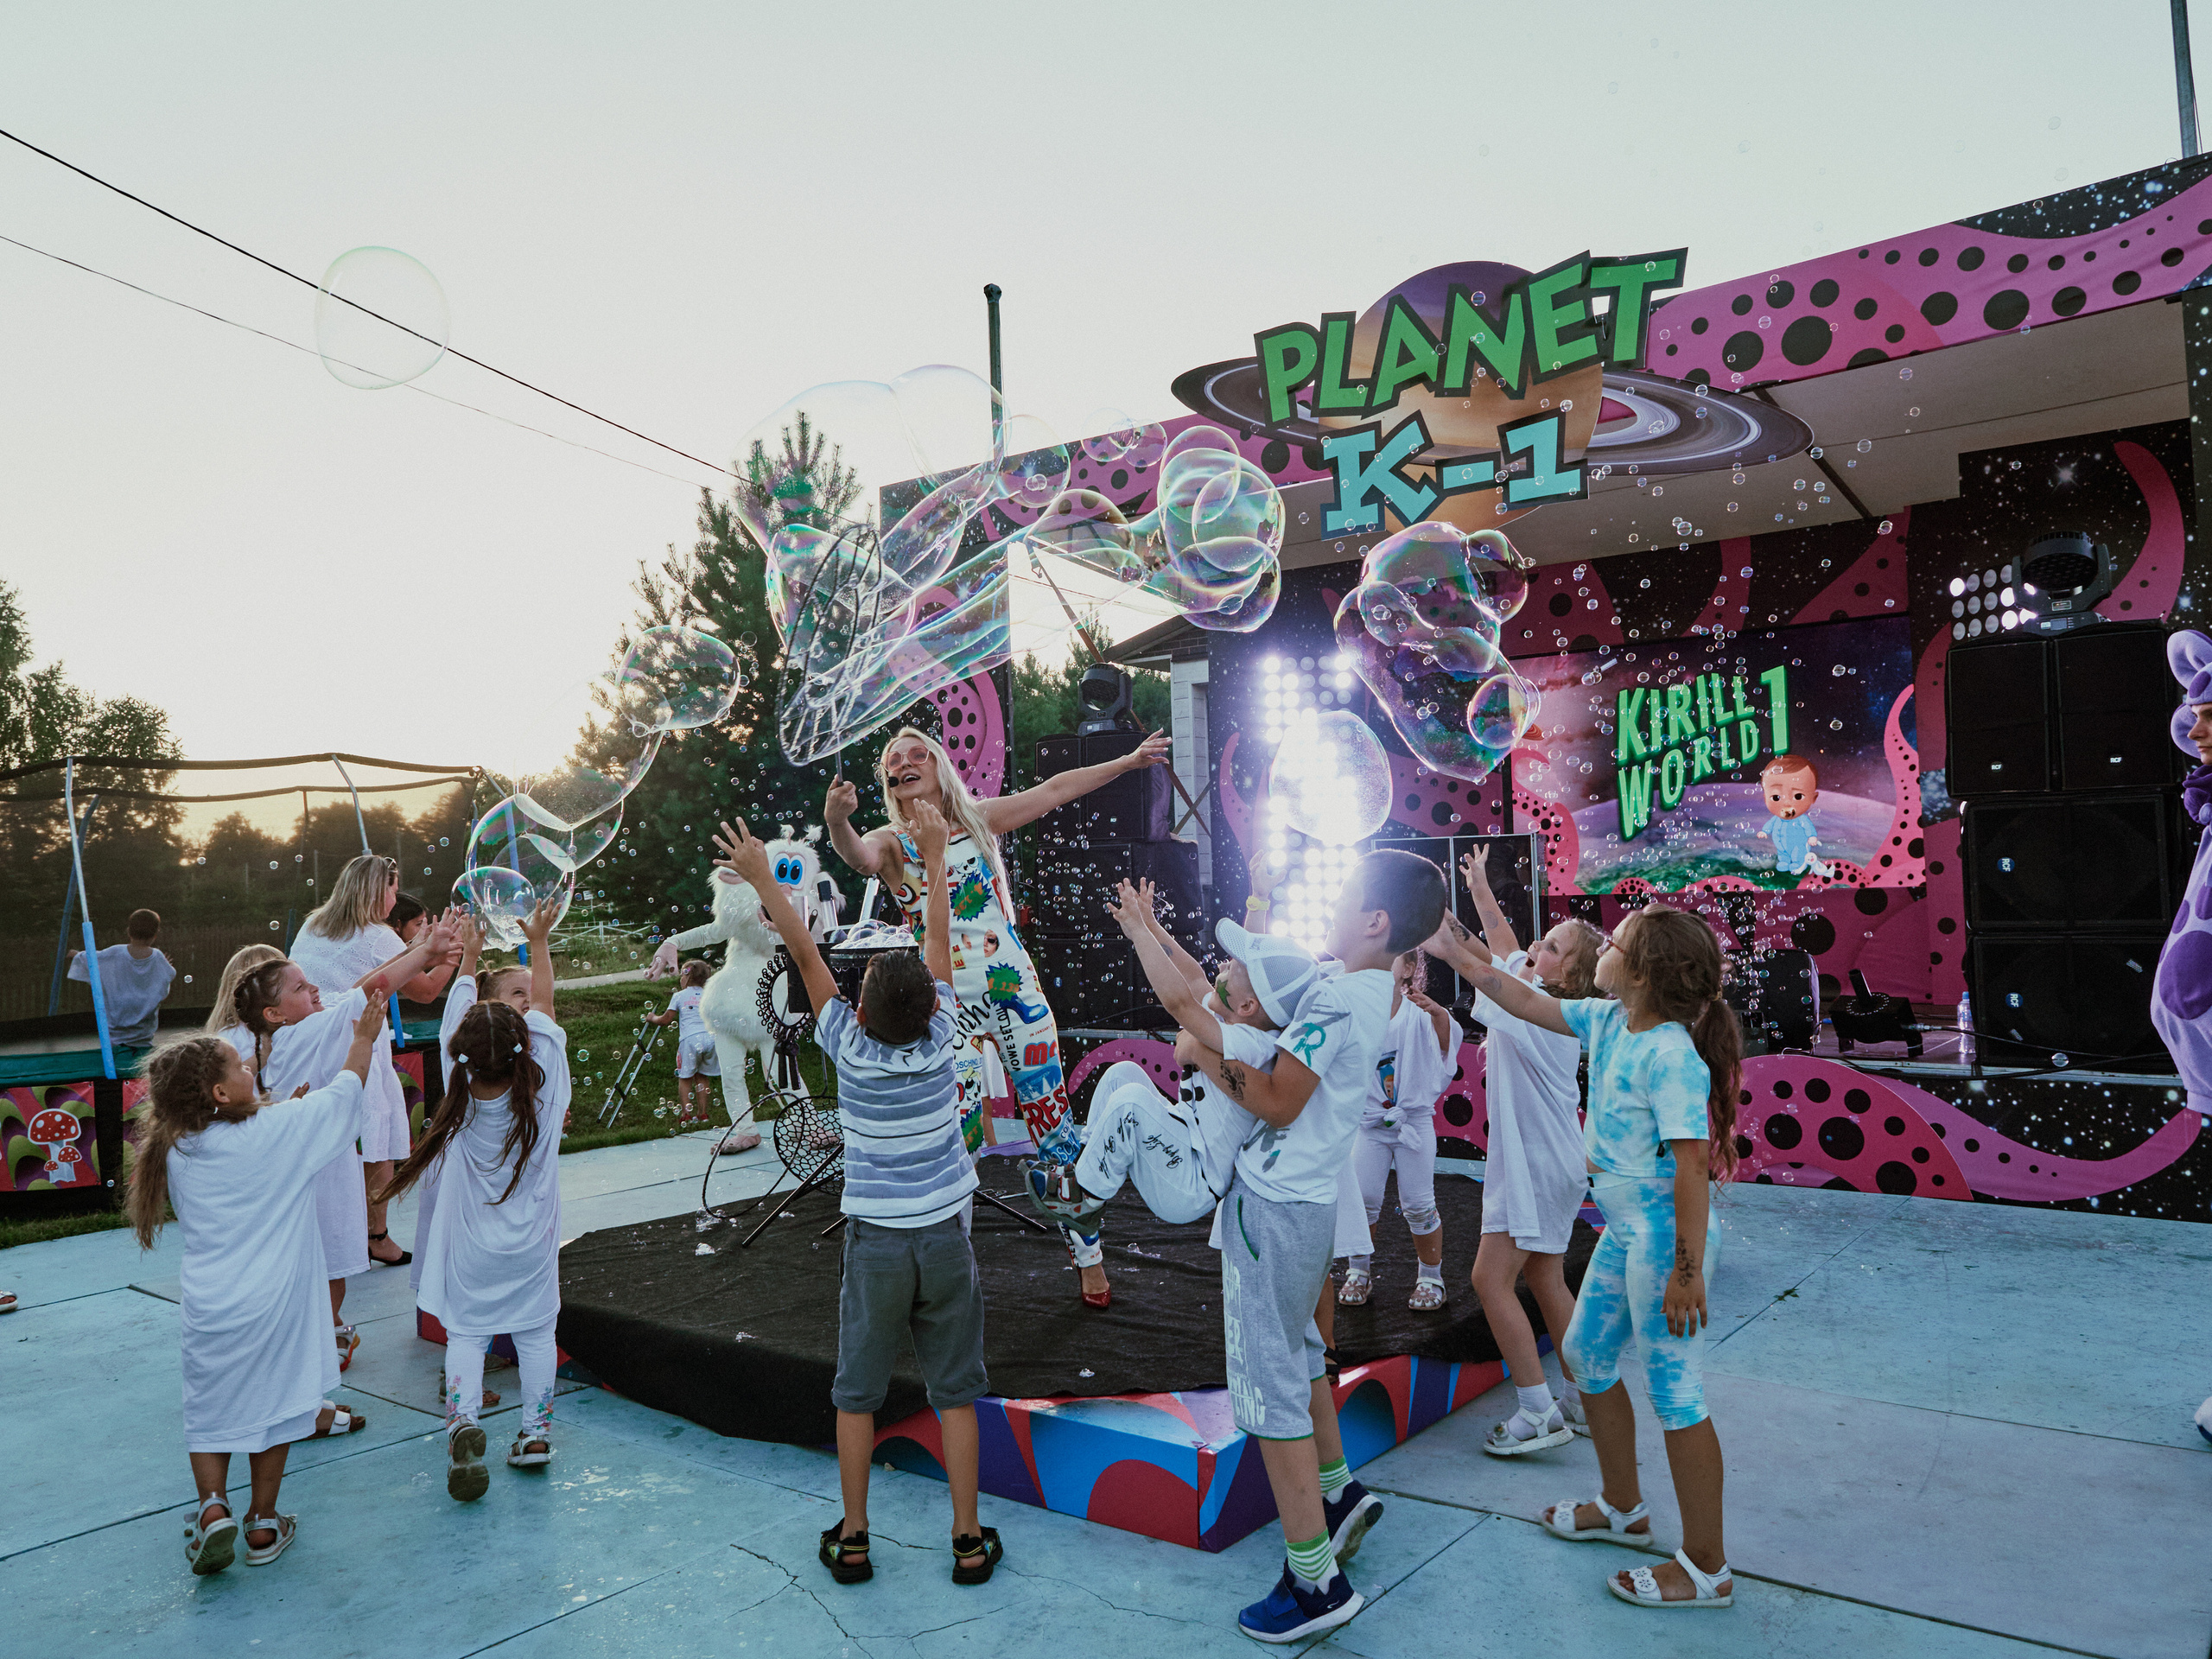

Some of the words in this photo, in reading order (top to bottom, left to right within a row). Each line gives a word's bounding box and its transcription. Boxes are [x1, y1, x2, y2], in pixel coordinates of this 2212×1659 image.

[1256, 251, 1685, 424] PLANET
[1322, 412, 1585, 537] K-1
[1617, 671, 1756, 765] KIRILL
[1760, 664, 1789, 755] 1
[1617, 719, 1761, 841] WORLD
[2002, 858, 2011, 872] RCF
[2010, 994, 2019, 1007] RCF
[1021, 1084, 1071, 1148] FRES
